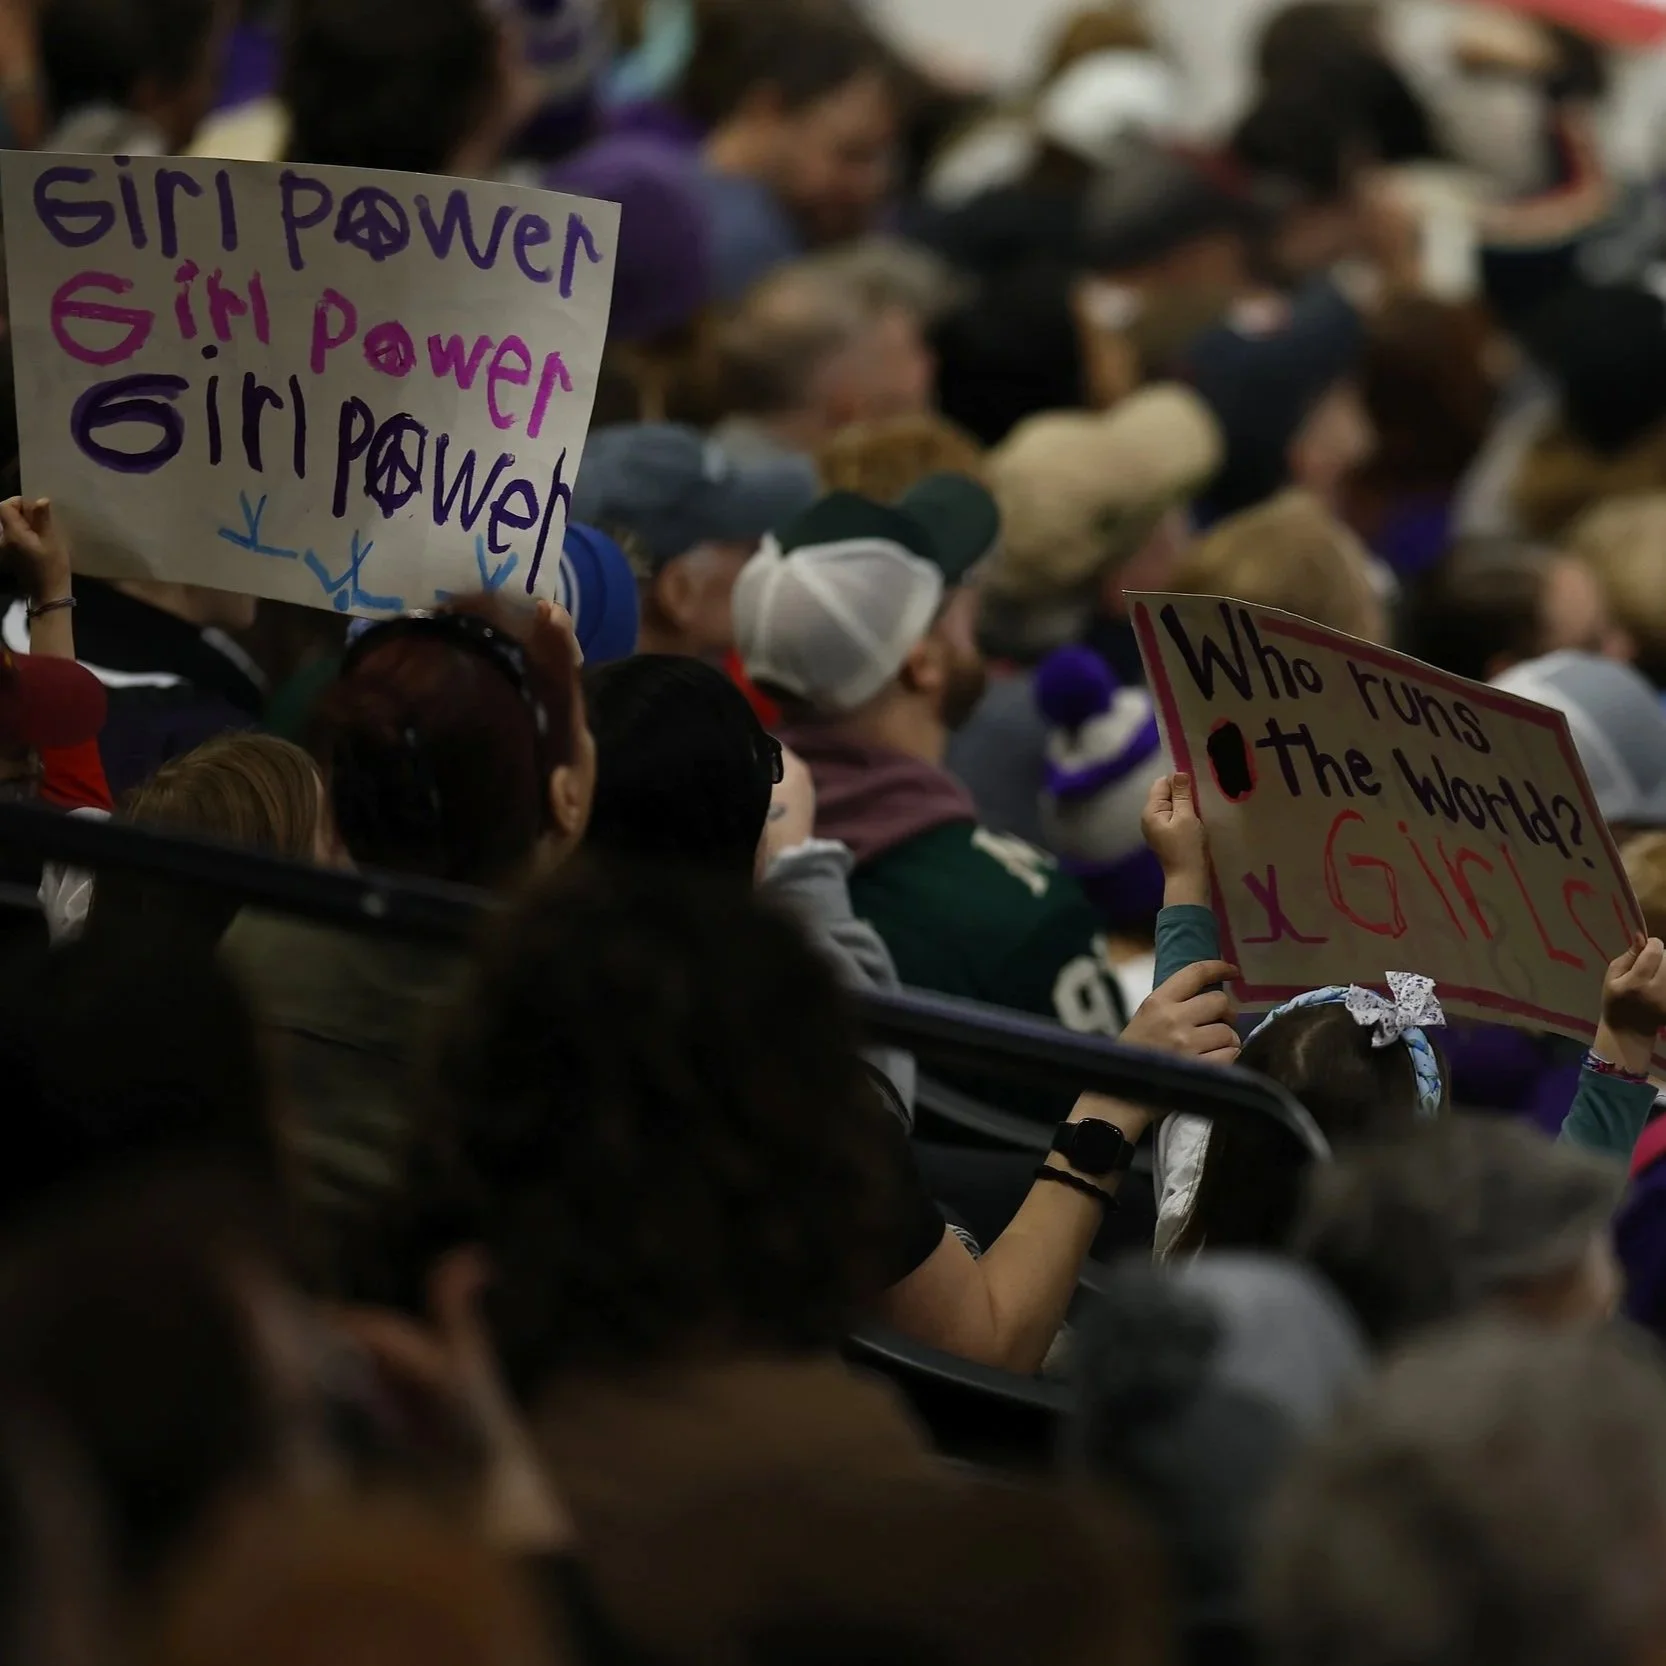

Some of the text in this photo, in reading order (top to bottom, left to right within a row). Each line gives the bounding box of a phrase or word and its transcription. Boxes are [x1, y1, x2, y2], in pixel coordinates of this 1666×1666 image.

[50, 258, 270, 365] Girl
[1159, 602, 1492, 754] Who runs
[1255, 717, 1382, 797] the
